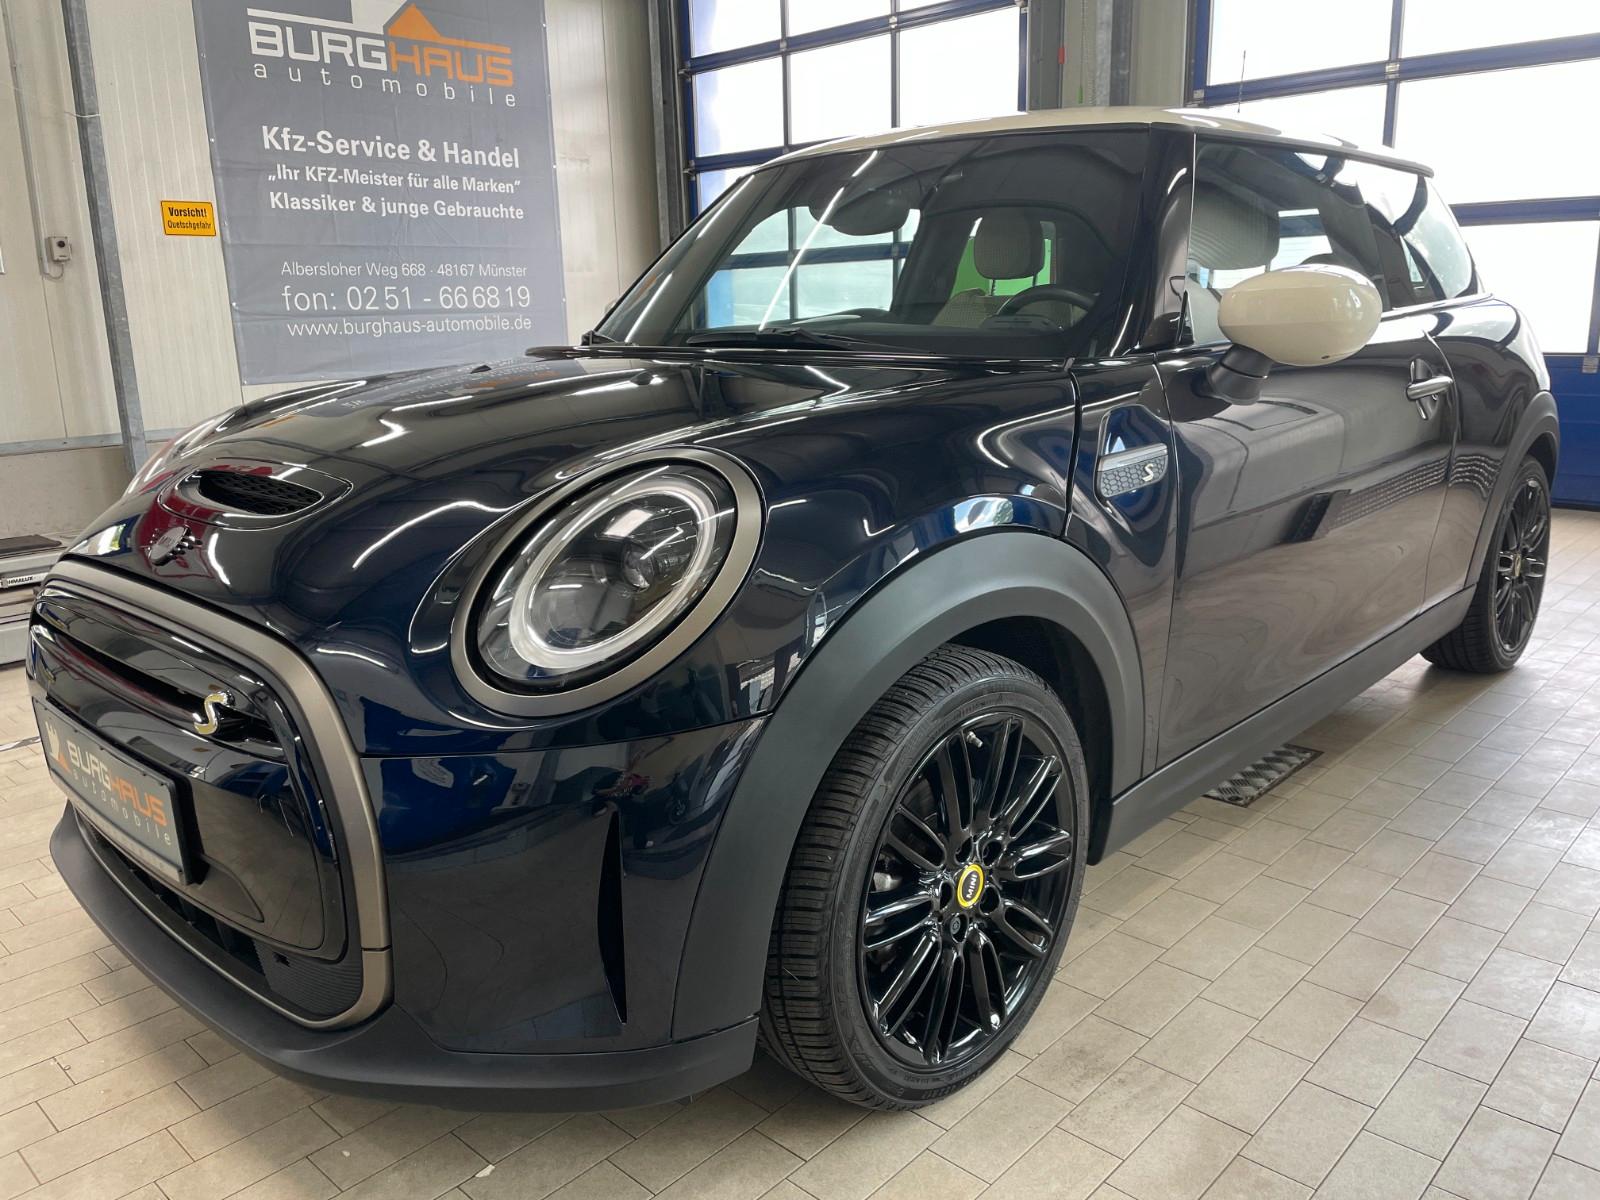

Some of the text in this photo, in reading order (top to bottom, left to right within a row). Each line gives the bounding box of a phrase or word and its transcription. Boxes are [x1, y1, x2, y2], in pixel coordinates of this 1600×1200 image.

[254, 62, 516, 107] automobile
[262, 125, 520, 168] Kfz-Service & Handel
[305, 166, 404, 187] KFZ-Meister
[407, 173, 429, 189] für
[433, 175, 459, 191] alle
[168, 206, 208, 218] Vorsicht!
[269, 191, 524, 219] Klassiker & junge Gebrauchte
[281, 261, 362, 277] Albersloher
[366, 262, 398, 279] Weg
[401, 263, 426, 277] 668
[437, 263, 474, 277] 48167
[479, 263, 527, 277] Münster
[281, 285, 337, 311] fon:
[287, 315, 532, 338] www.burghaus-automobile.de
[66, 739, 167, 827] BURGHAUS
[73, 771, 171, 846] automobile
[966, 874, 978, 899] MINI
